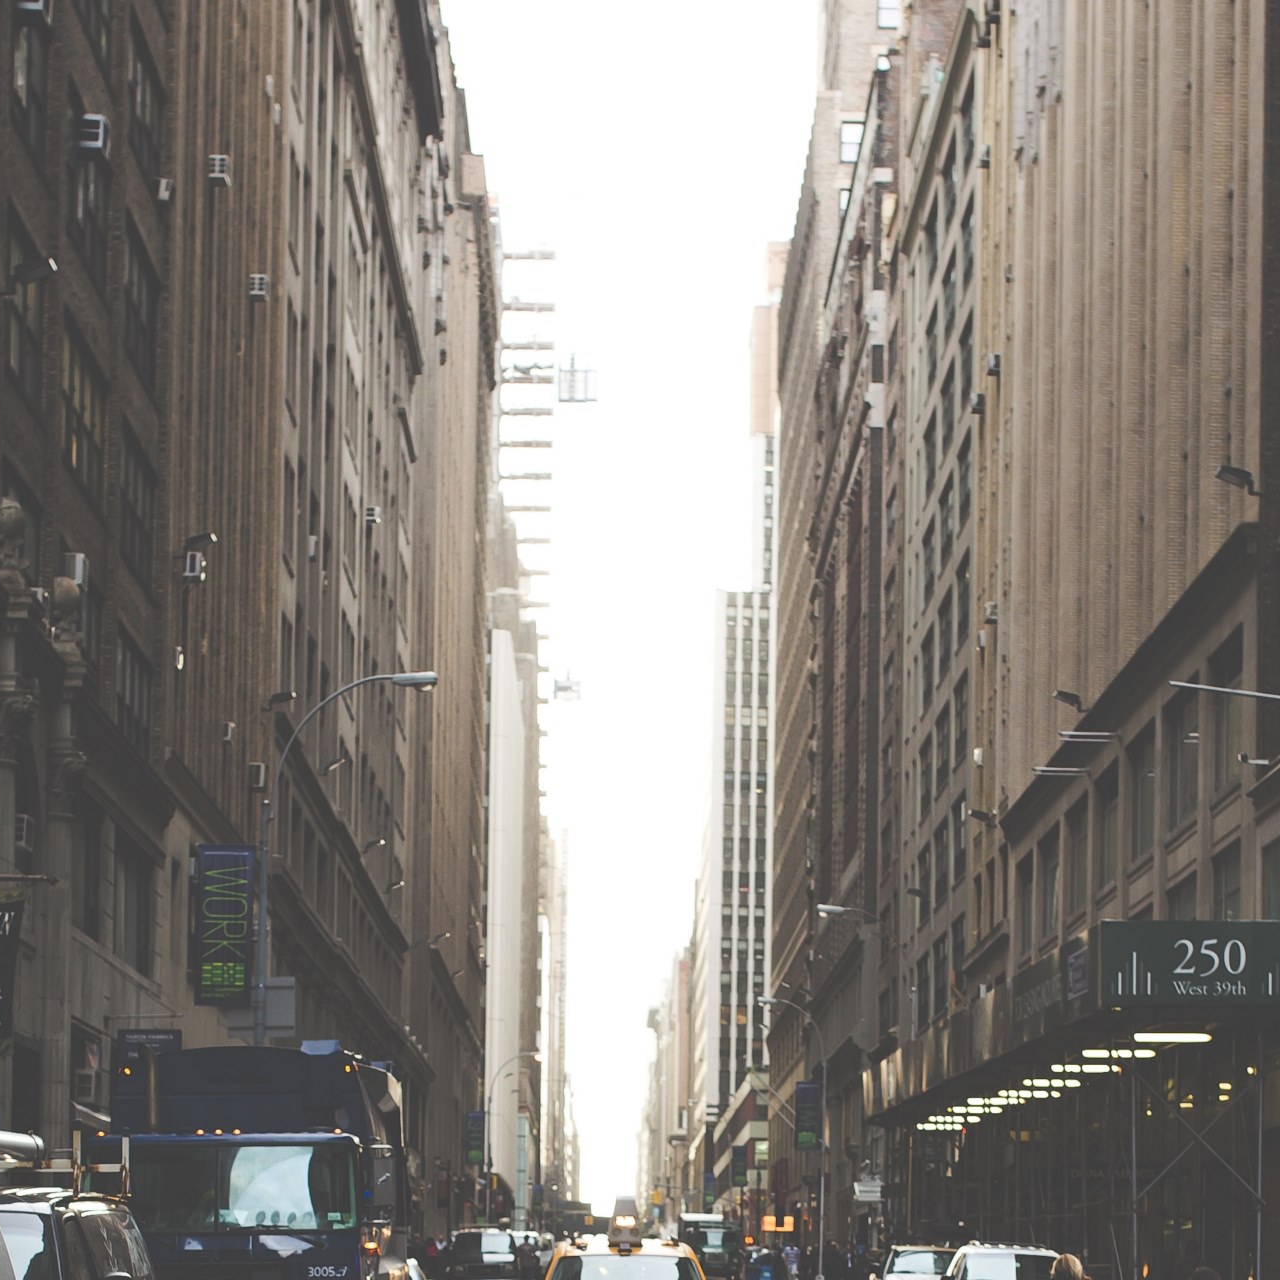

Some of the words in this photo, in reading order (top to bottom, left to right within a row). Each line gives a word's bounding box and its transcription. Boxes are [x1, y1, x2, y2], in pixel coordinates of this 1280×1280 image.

[201, 866, 250, 958] WORK
[1172, 937, 1247, 978] 250
[1172, 979, 1208, 997] West
[1212, 979, 1247, 997] 39th
